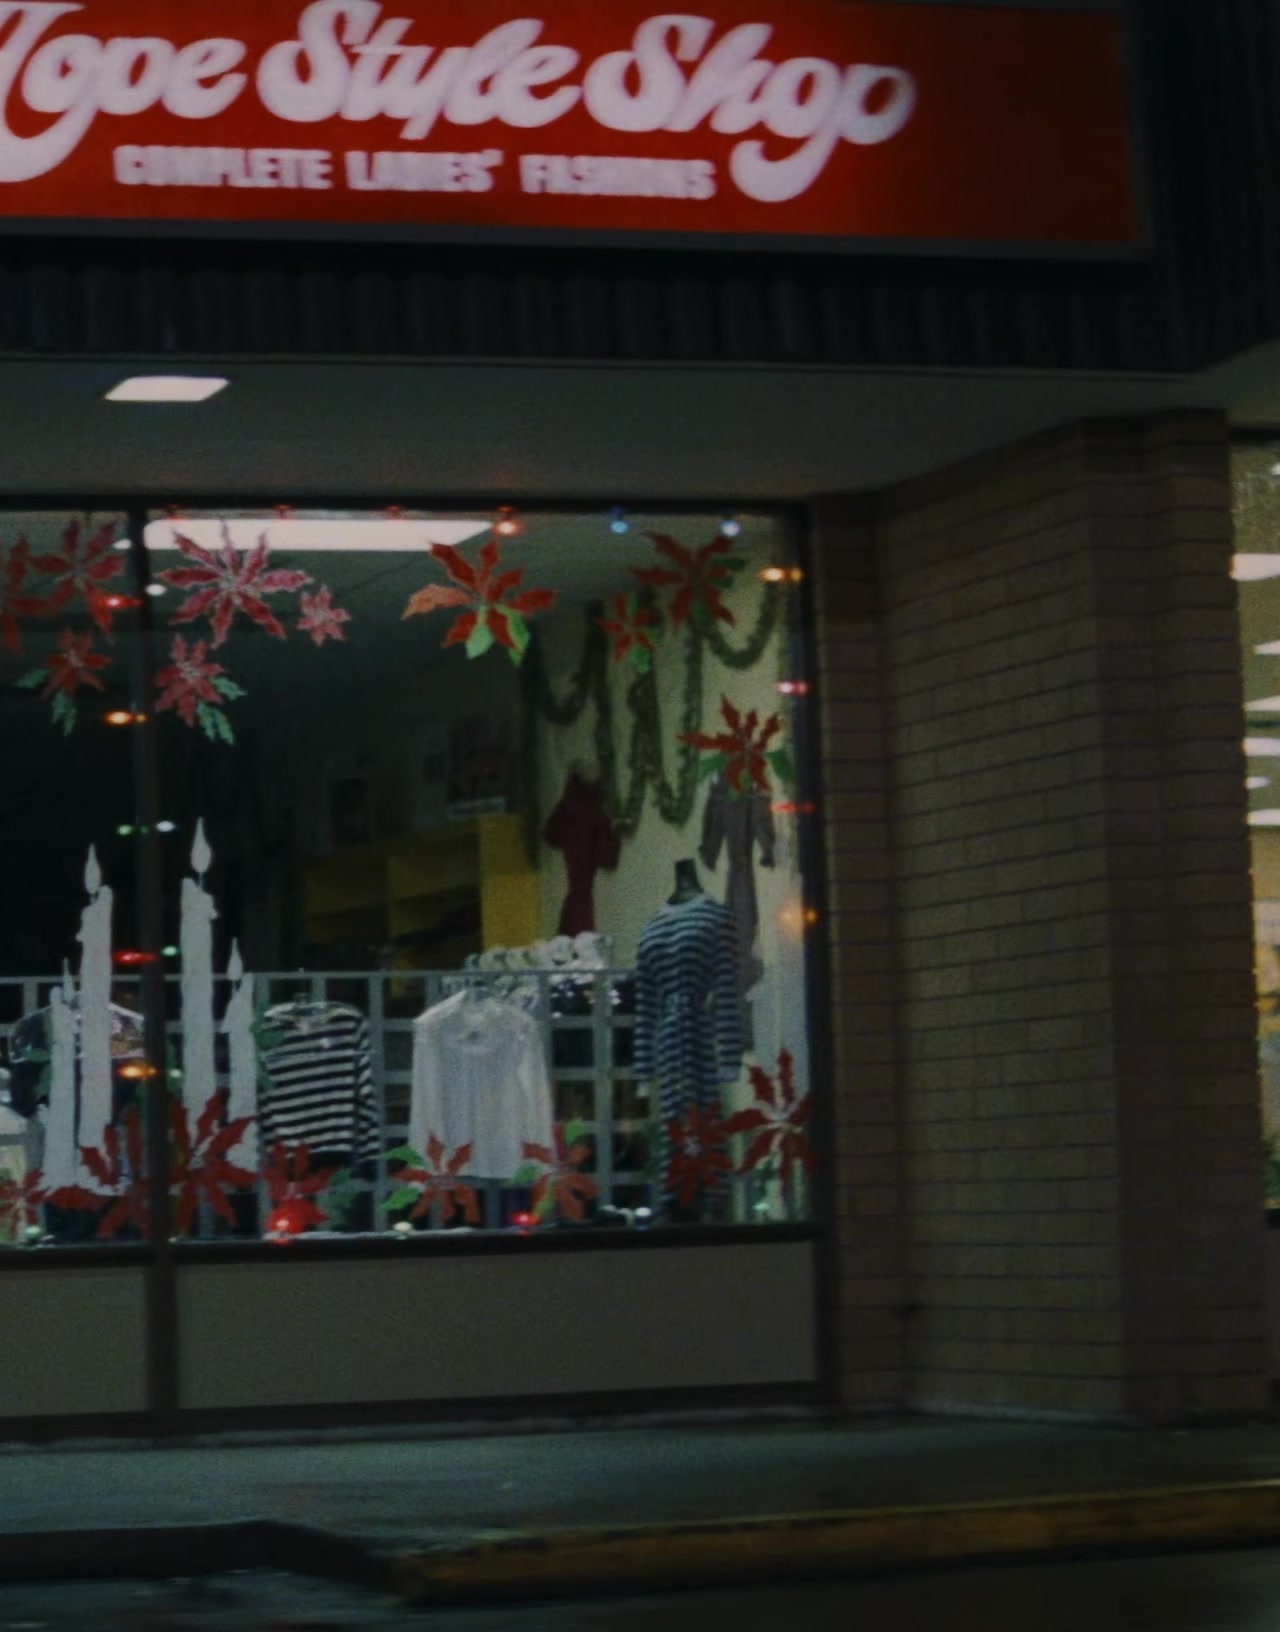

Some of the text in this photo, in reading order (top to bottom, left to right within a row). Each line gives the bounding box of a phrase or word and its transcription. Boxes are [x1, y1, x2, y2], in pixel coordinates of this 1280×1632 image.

[256, 0, 582, 140] Style
[584, 14, 918, 203] Shop
[113, 145, 333, 190] COMPLETE
[519, 154, 717, 200] FASHIONS
